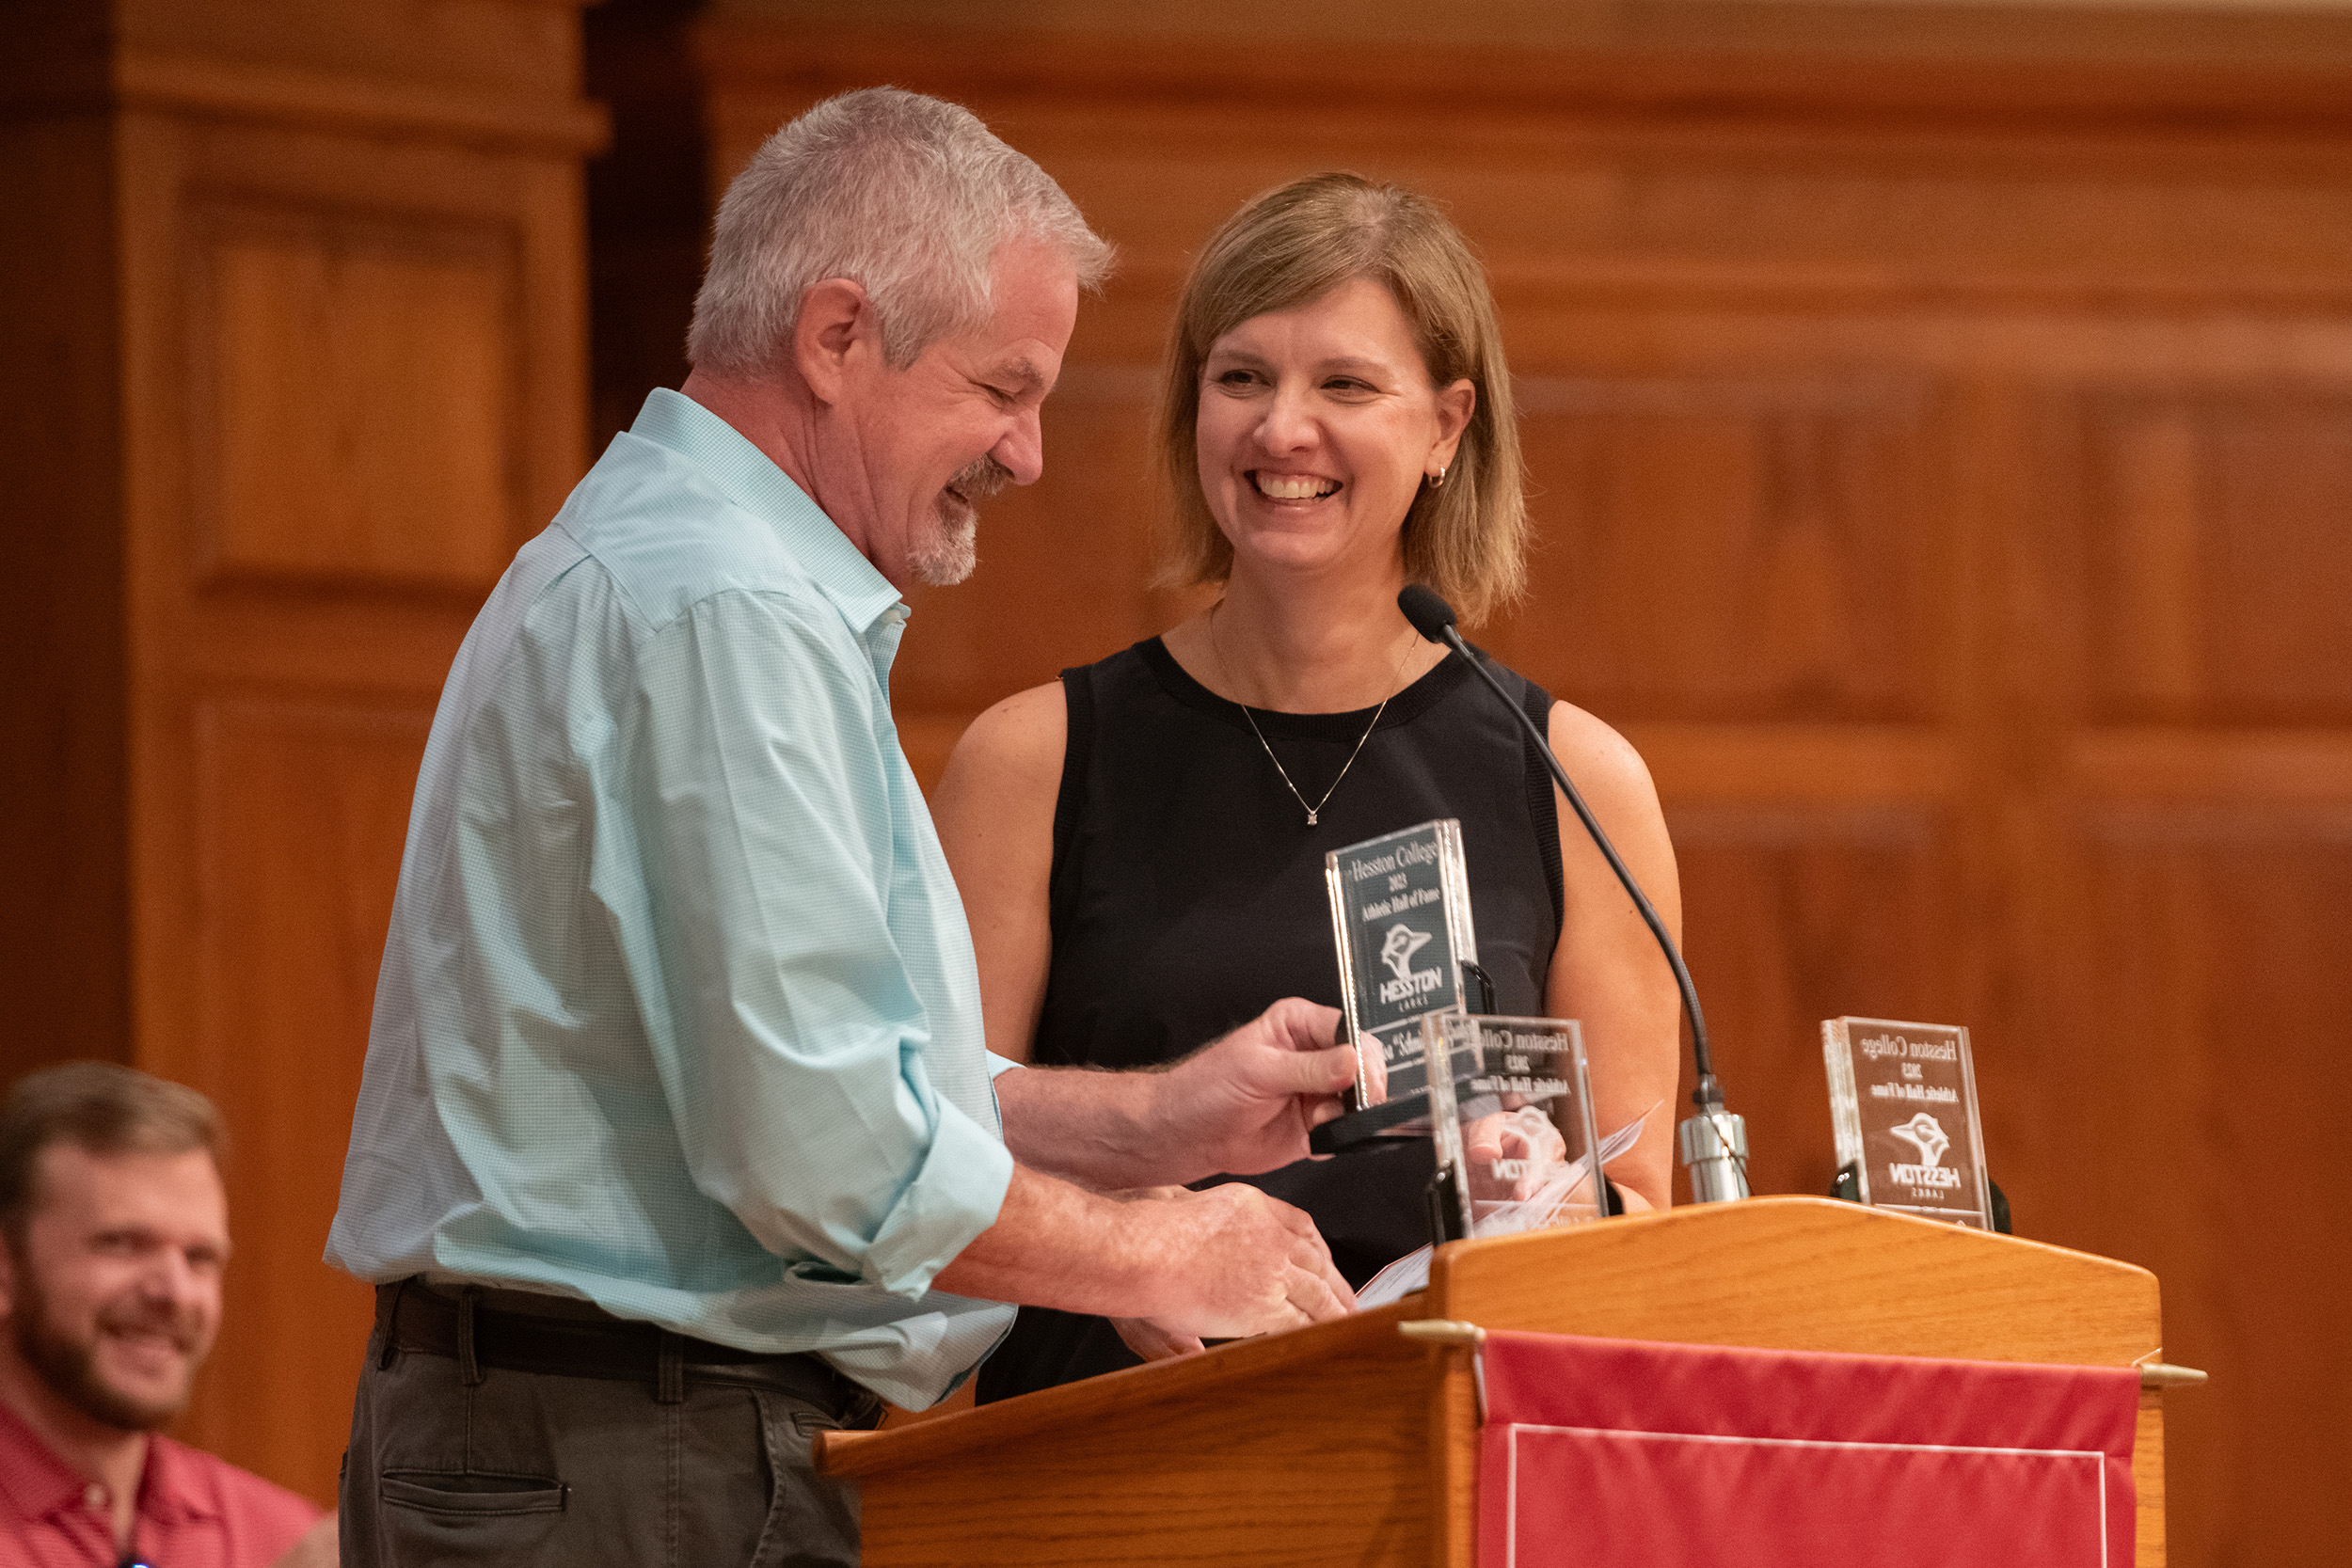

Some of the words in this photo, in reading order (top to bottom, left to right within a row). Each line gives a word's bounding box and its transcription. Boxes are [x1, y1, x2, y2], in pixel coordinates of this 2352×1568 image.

[1352, 856, 1395, 881] Hesston
[1395, 841, 1438, 866] College
[1391, 893, 1411, 912] Hall
[1418, 887, 1440, 906] Fame
[1379, 966, 1442, 1005] HESSTON
